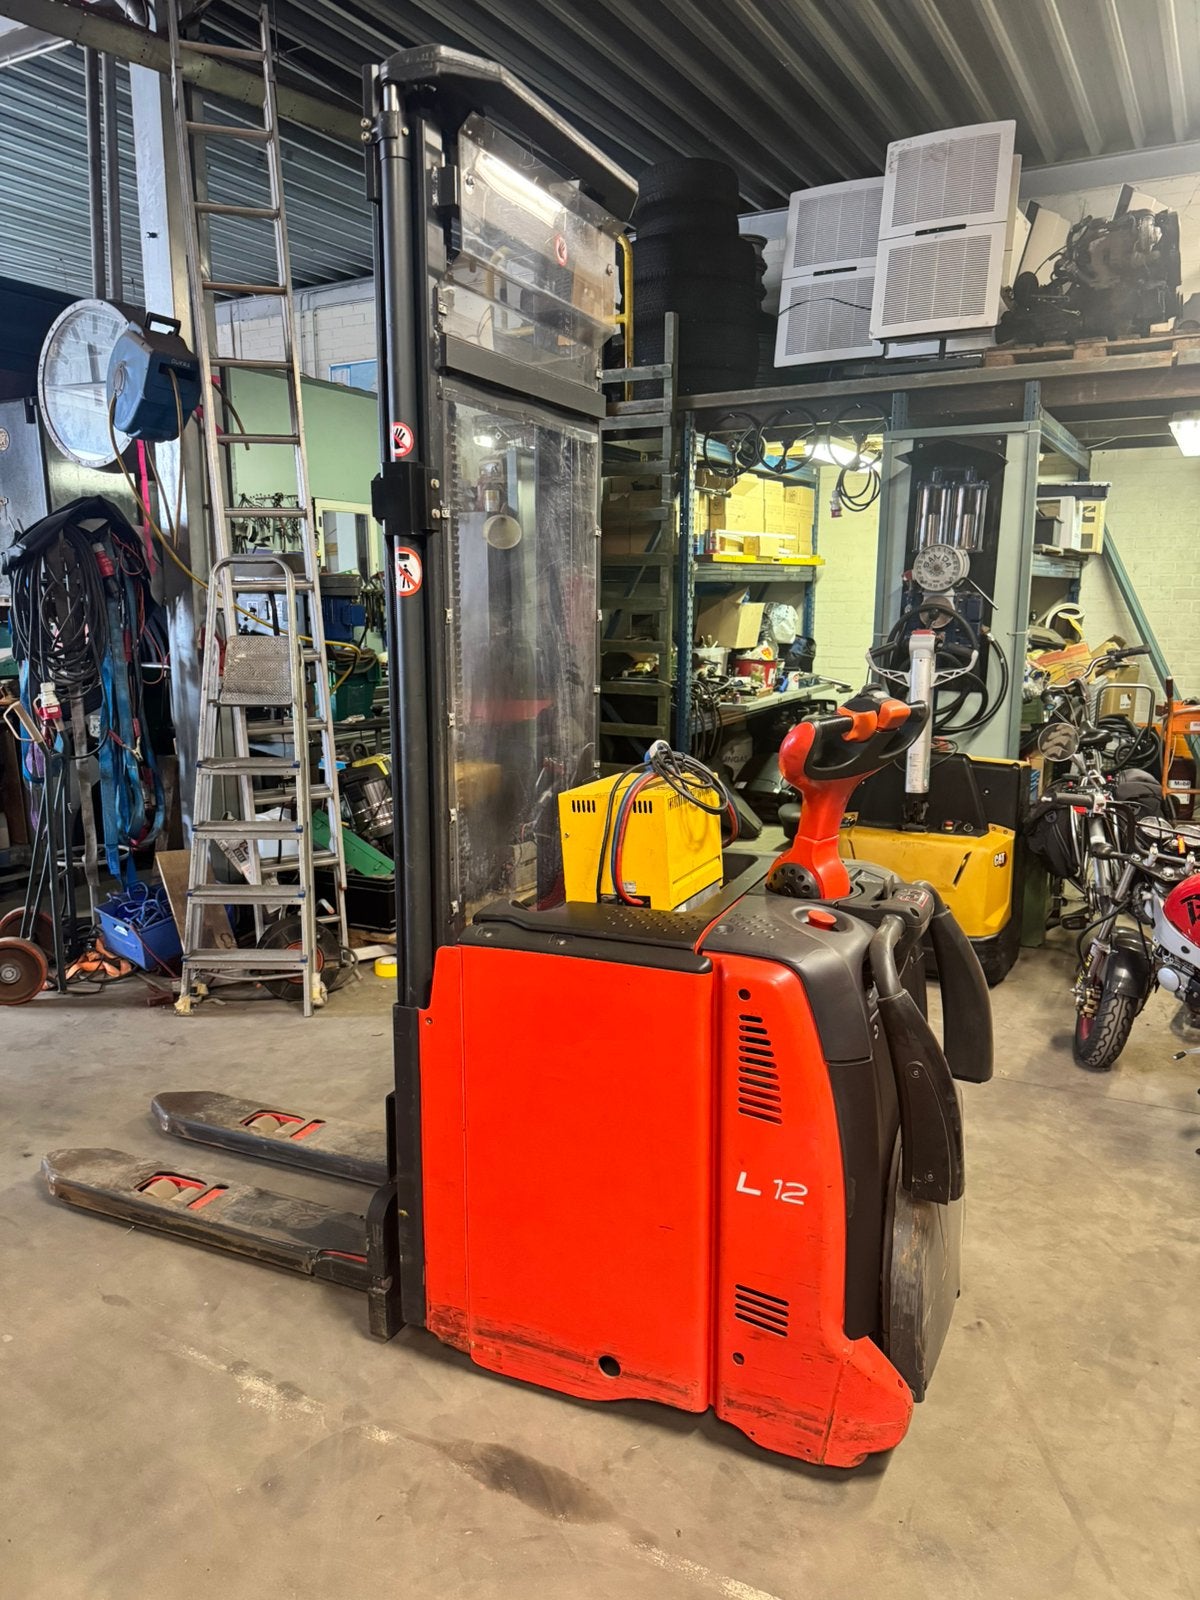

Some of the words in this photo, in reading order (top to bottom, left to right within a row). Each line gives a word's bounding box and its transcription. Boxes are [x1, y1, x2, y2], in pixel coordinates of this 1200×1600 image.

[994, 852, 1006, 867] CAT
[736, 1171, 761, 1196] L
[773, 1179, 808, 1205] 12
